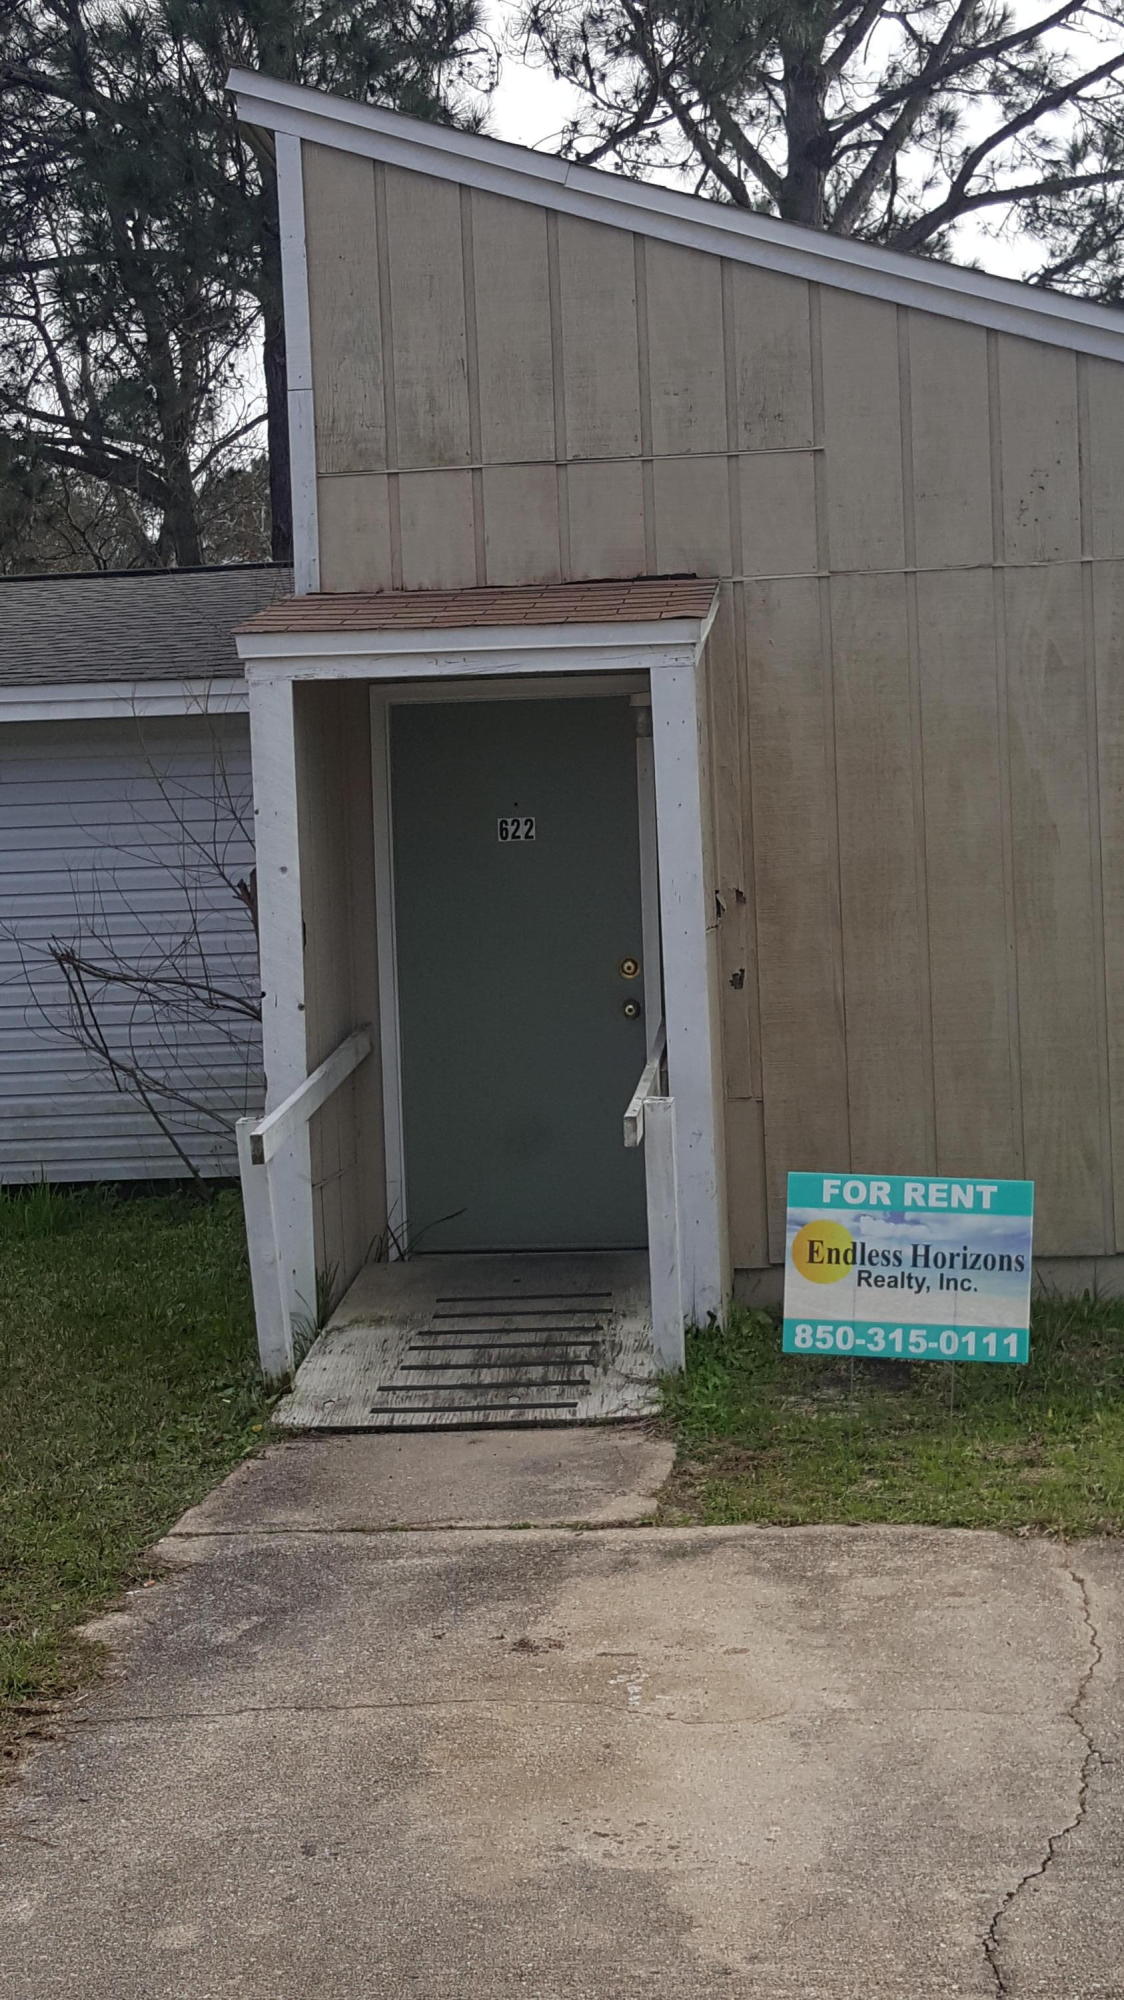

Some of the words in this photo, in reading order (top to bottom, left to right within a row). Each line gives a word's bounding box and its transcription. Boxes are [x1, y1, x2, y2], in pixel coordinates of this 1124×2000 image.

[500, 819, 534, 840] 622
[822, 1179, 891, 1205] FOR
[904, 1182, 998, 1209] RENT
[807, 1239, 903, 1268] Endless
[911, 1243, 1025, 1272] Horizons
[857, 1270, 930, 1294] Realty,
[939, 1273, 978, 1292] Inc.
[794, 1324, 1018, 1358] 850-315-0111
